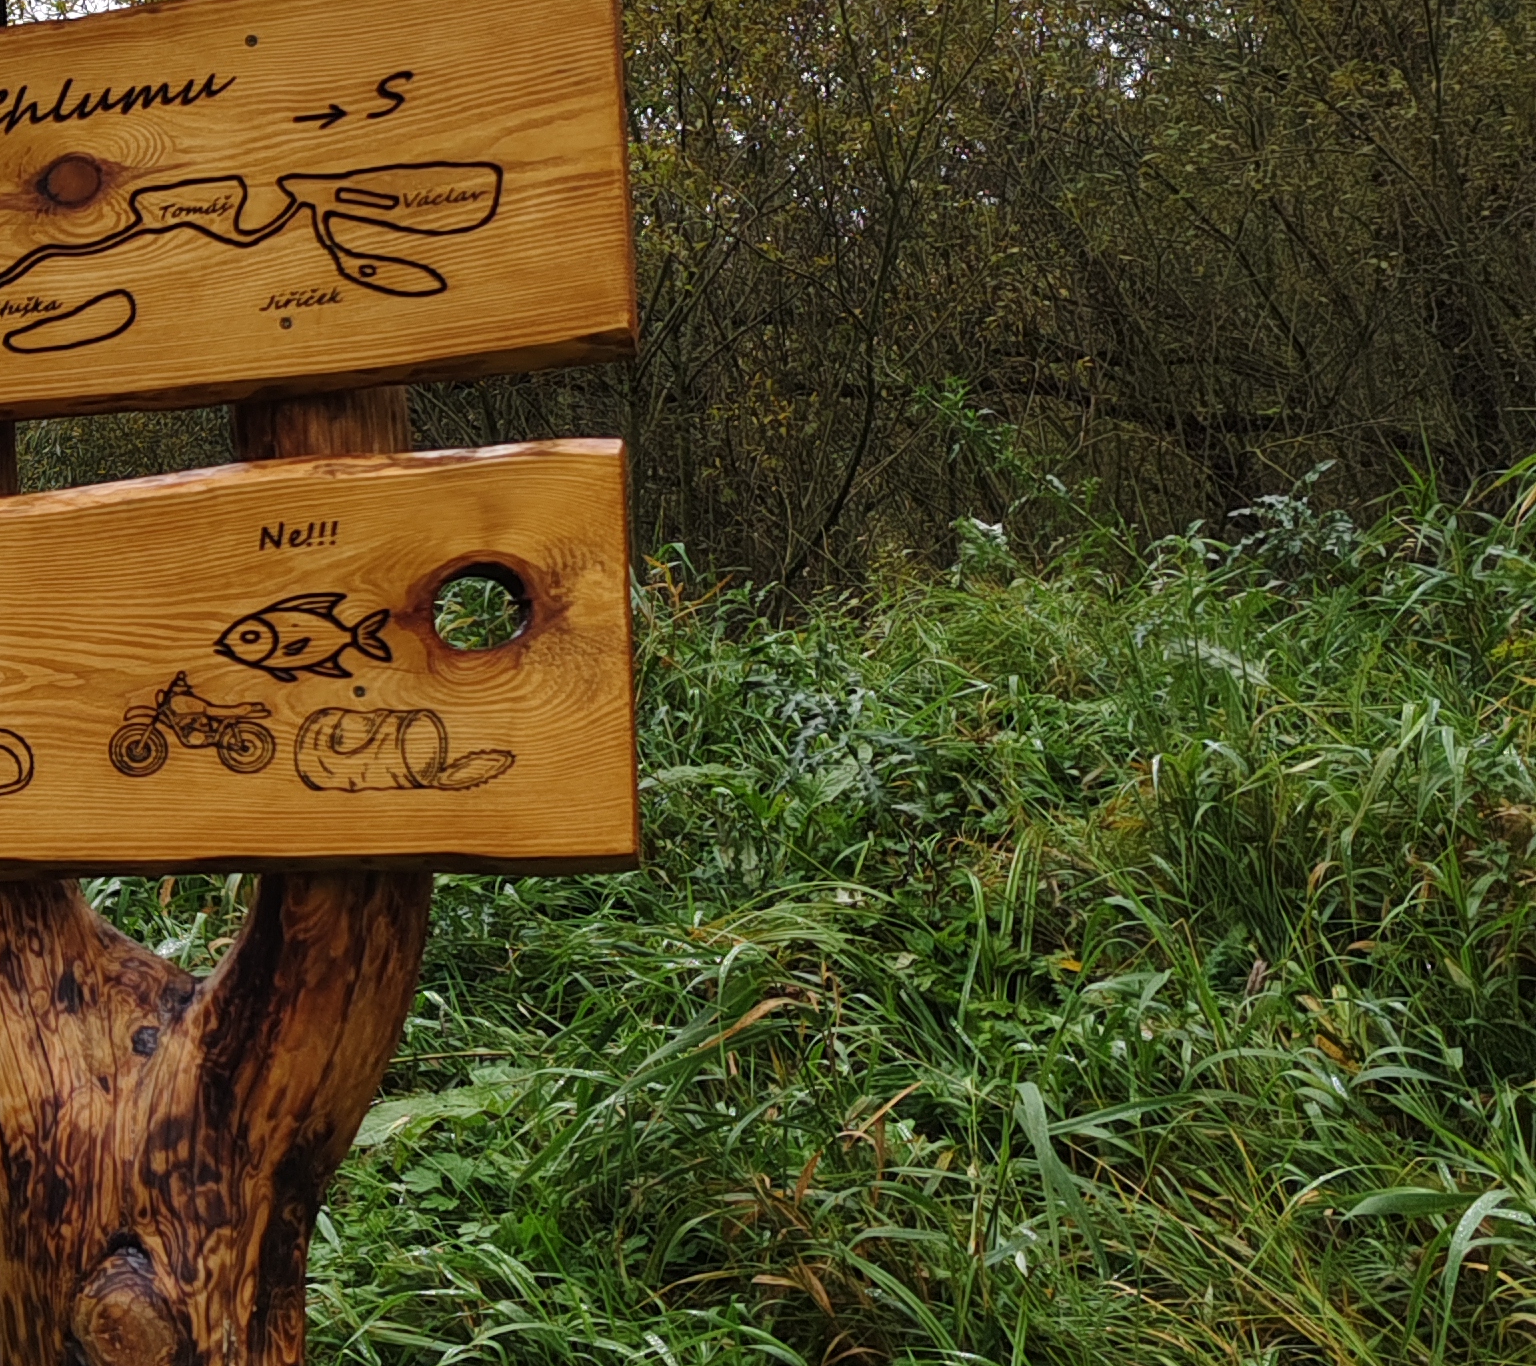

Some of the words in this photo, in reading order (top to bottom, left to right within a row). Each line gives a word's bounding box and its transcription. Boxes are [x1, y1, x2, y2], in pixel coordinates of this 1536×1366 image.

[365, 70, 415, 119] S
[159, 194, 235, 221] Tomáš
[402, 187, 492, 210] Václav
[258, 520, 339, 551] Ne!!!
